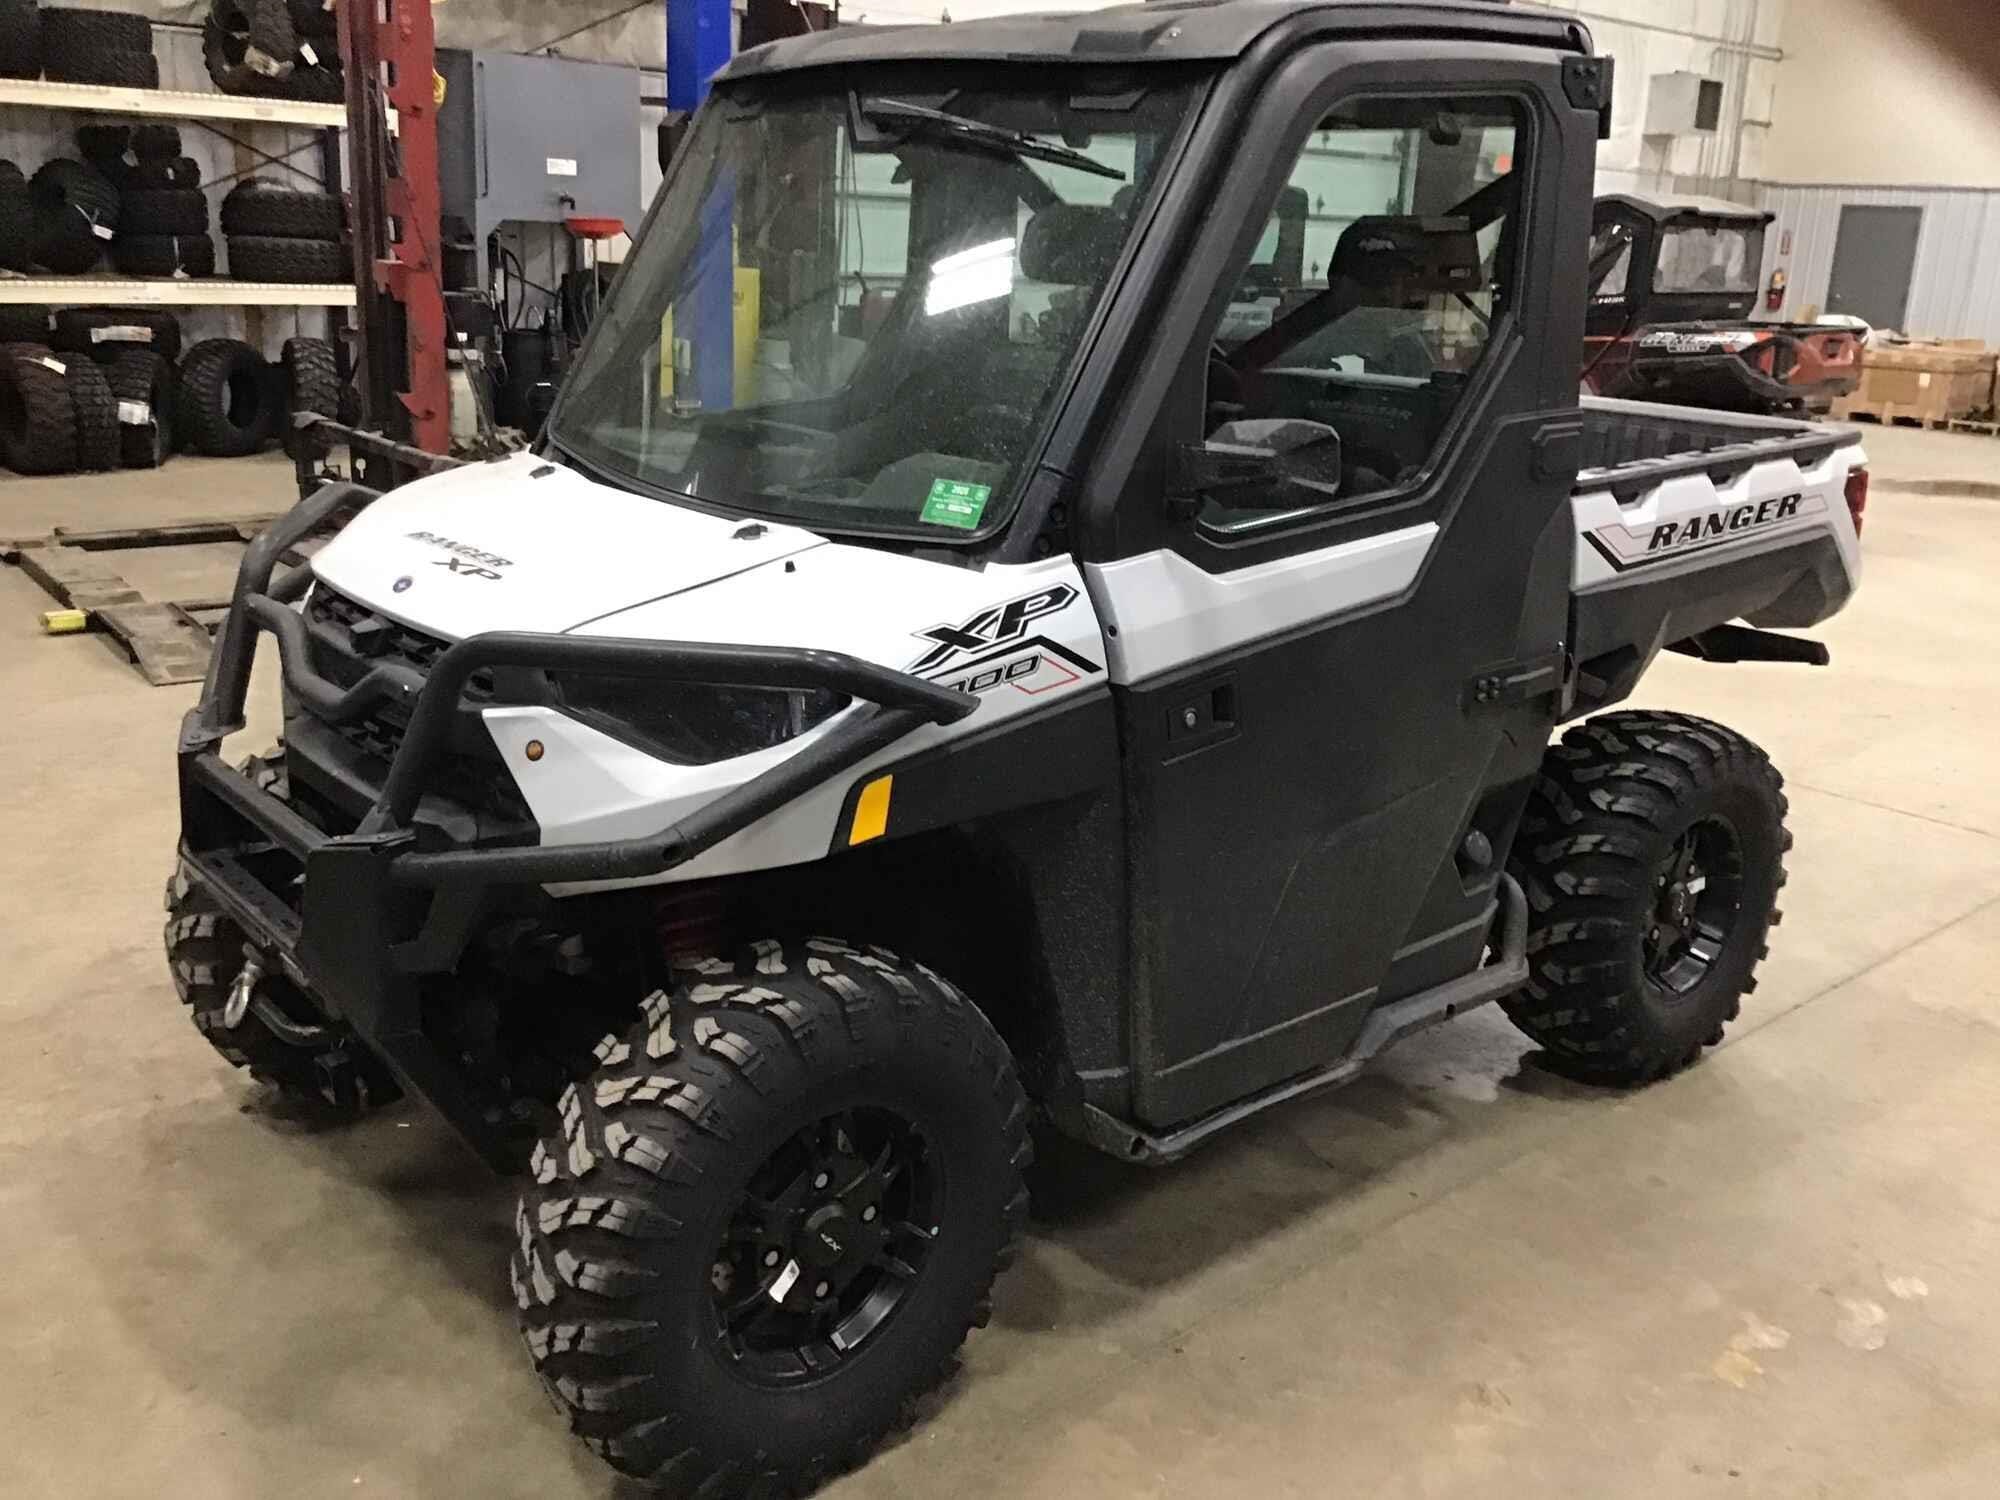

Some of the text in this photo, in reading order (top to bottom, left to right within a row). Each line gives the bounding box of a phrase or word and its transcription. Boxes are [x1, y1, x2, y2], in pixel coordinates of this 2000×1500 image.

[1648, 493, 1802, 550] RANGER
[405, 531, 514, 567] RANGER
[431, 557, 503, 580] XP
[905, 583, 1080, 675] XP
